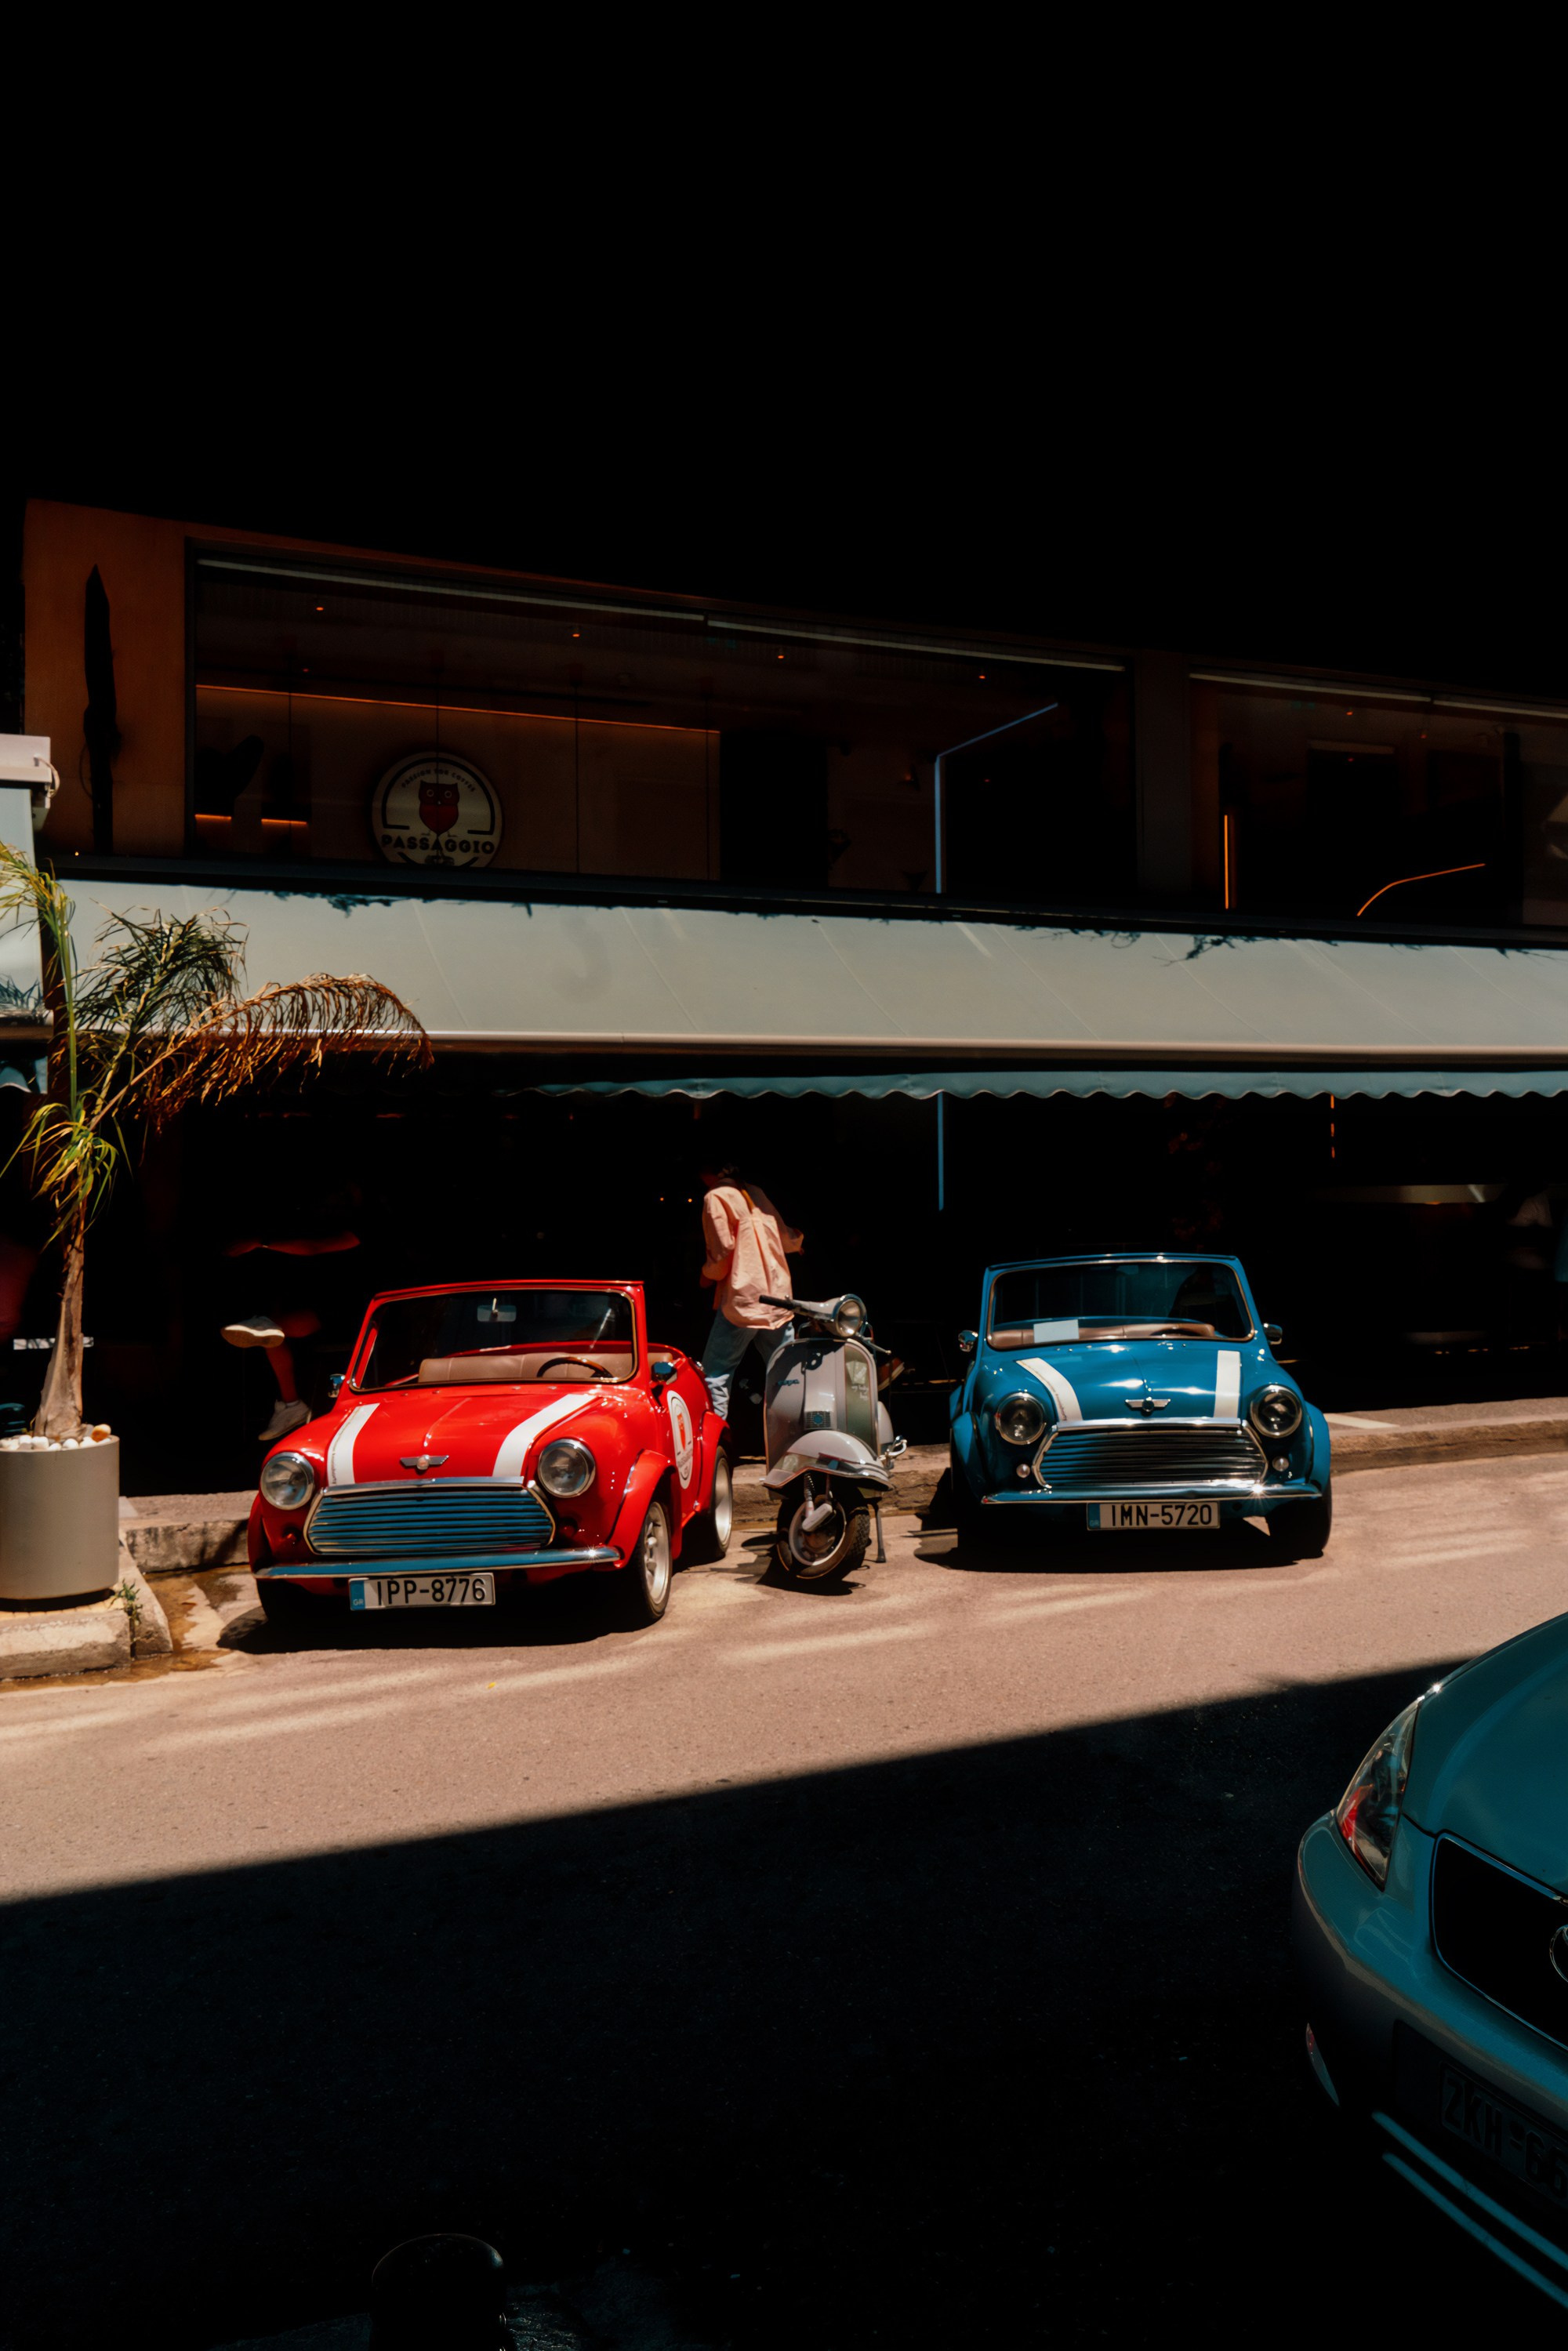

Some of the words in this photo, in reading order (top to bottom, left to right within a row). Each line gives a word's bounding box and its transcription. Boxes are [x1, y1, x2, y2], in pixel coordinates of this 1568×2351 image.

[381, 834, 495, 854] PASSAGGIO
[1112, 1504, 1211, 1526] IMN-5720
[377, 1578, 485, 1605] IPP-8776
